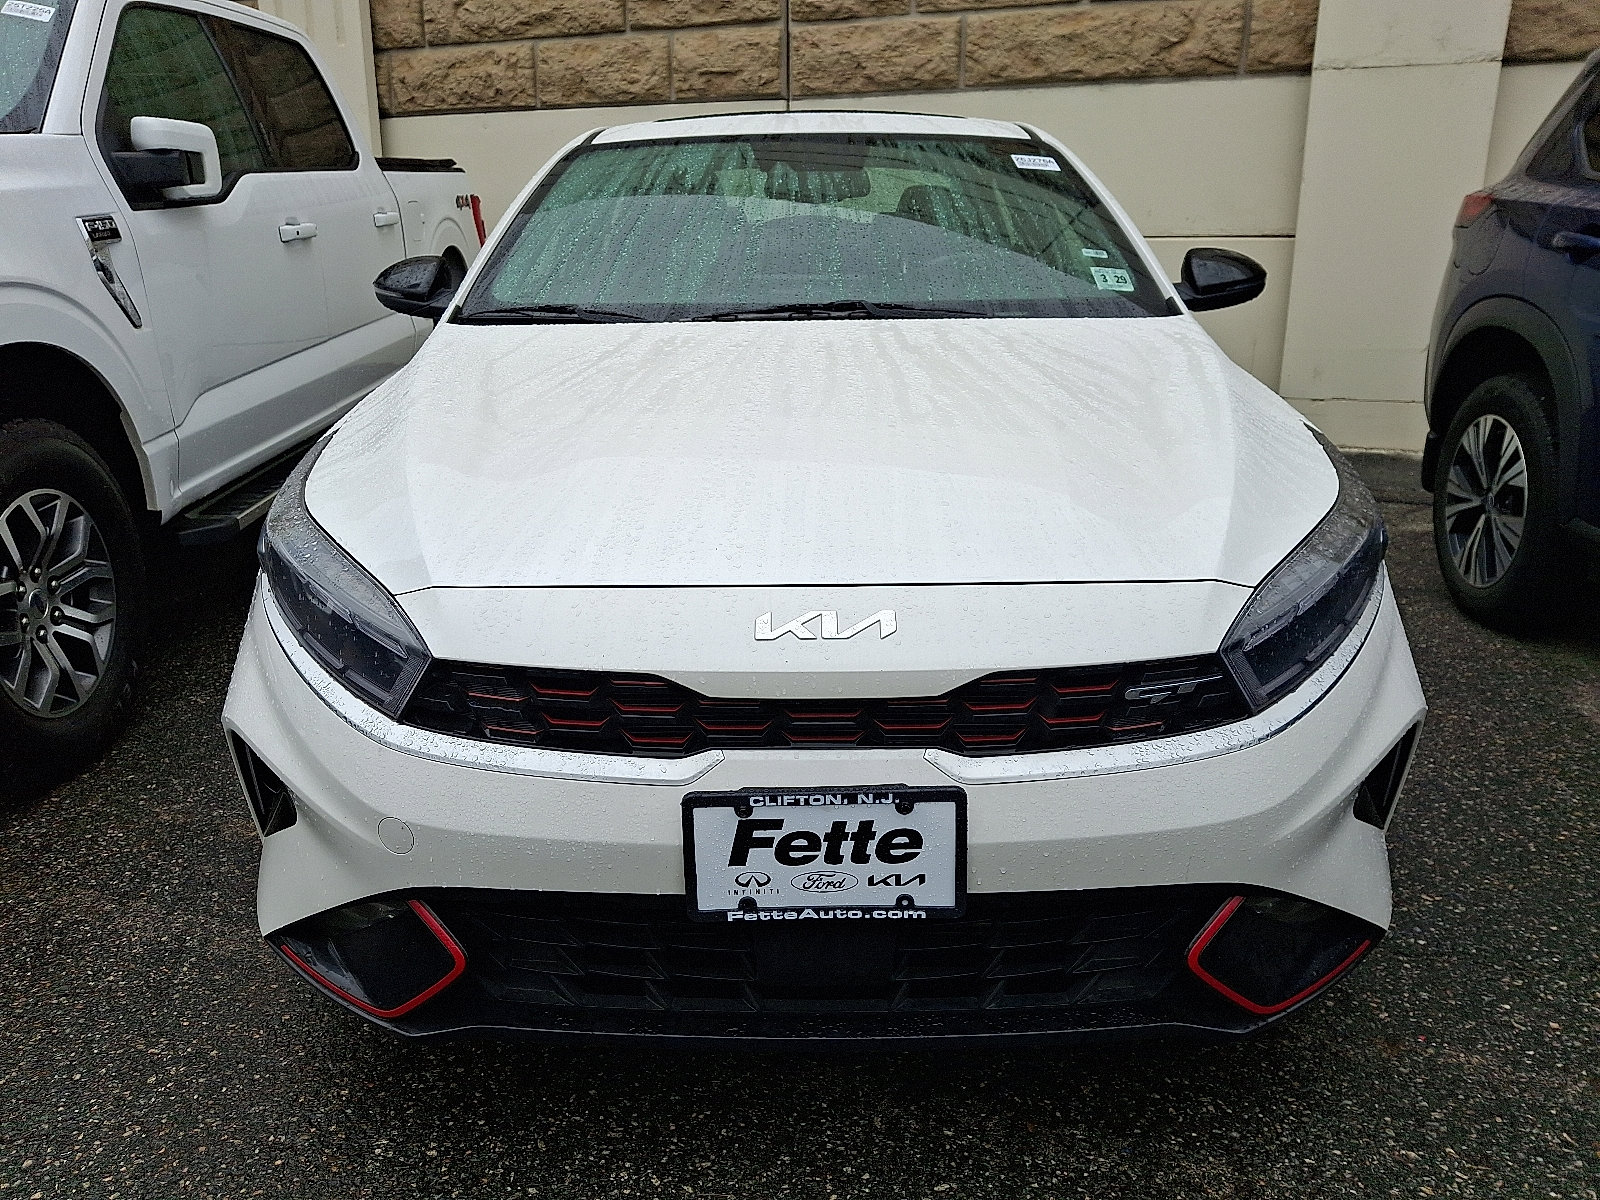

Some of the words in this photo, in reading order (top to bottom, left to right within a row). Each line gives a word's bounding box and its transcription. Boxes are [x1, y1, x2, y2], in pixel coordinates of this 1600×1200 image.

[1099, 273, 1109, 283] 3
[1113, 275, 1128, 284] 29
[754, 609, 898, 641] KIA
[749, 794, 848, 807] CLIFTON,
[857, 793, 900, 804] N.J.
[727, 818, 925, 867] Fette
[802, 873, 847, 892] Ford
[867, 873, 926, 887] KIA
[728, 888, 780, 896] INFINITI
[727, 908, 927, 921] FetteAuto.com
